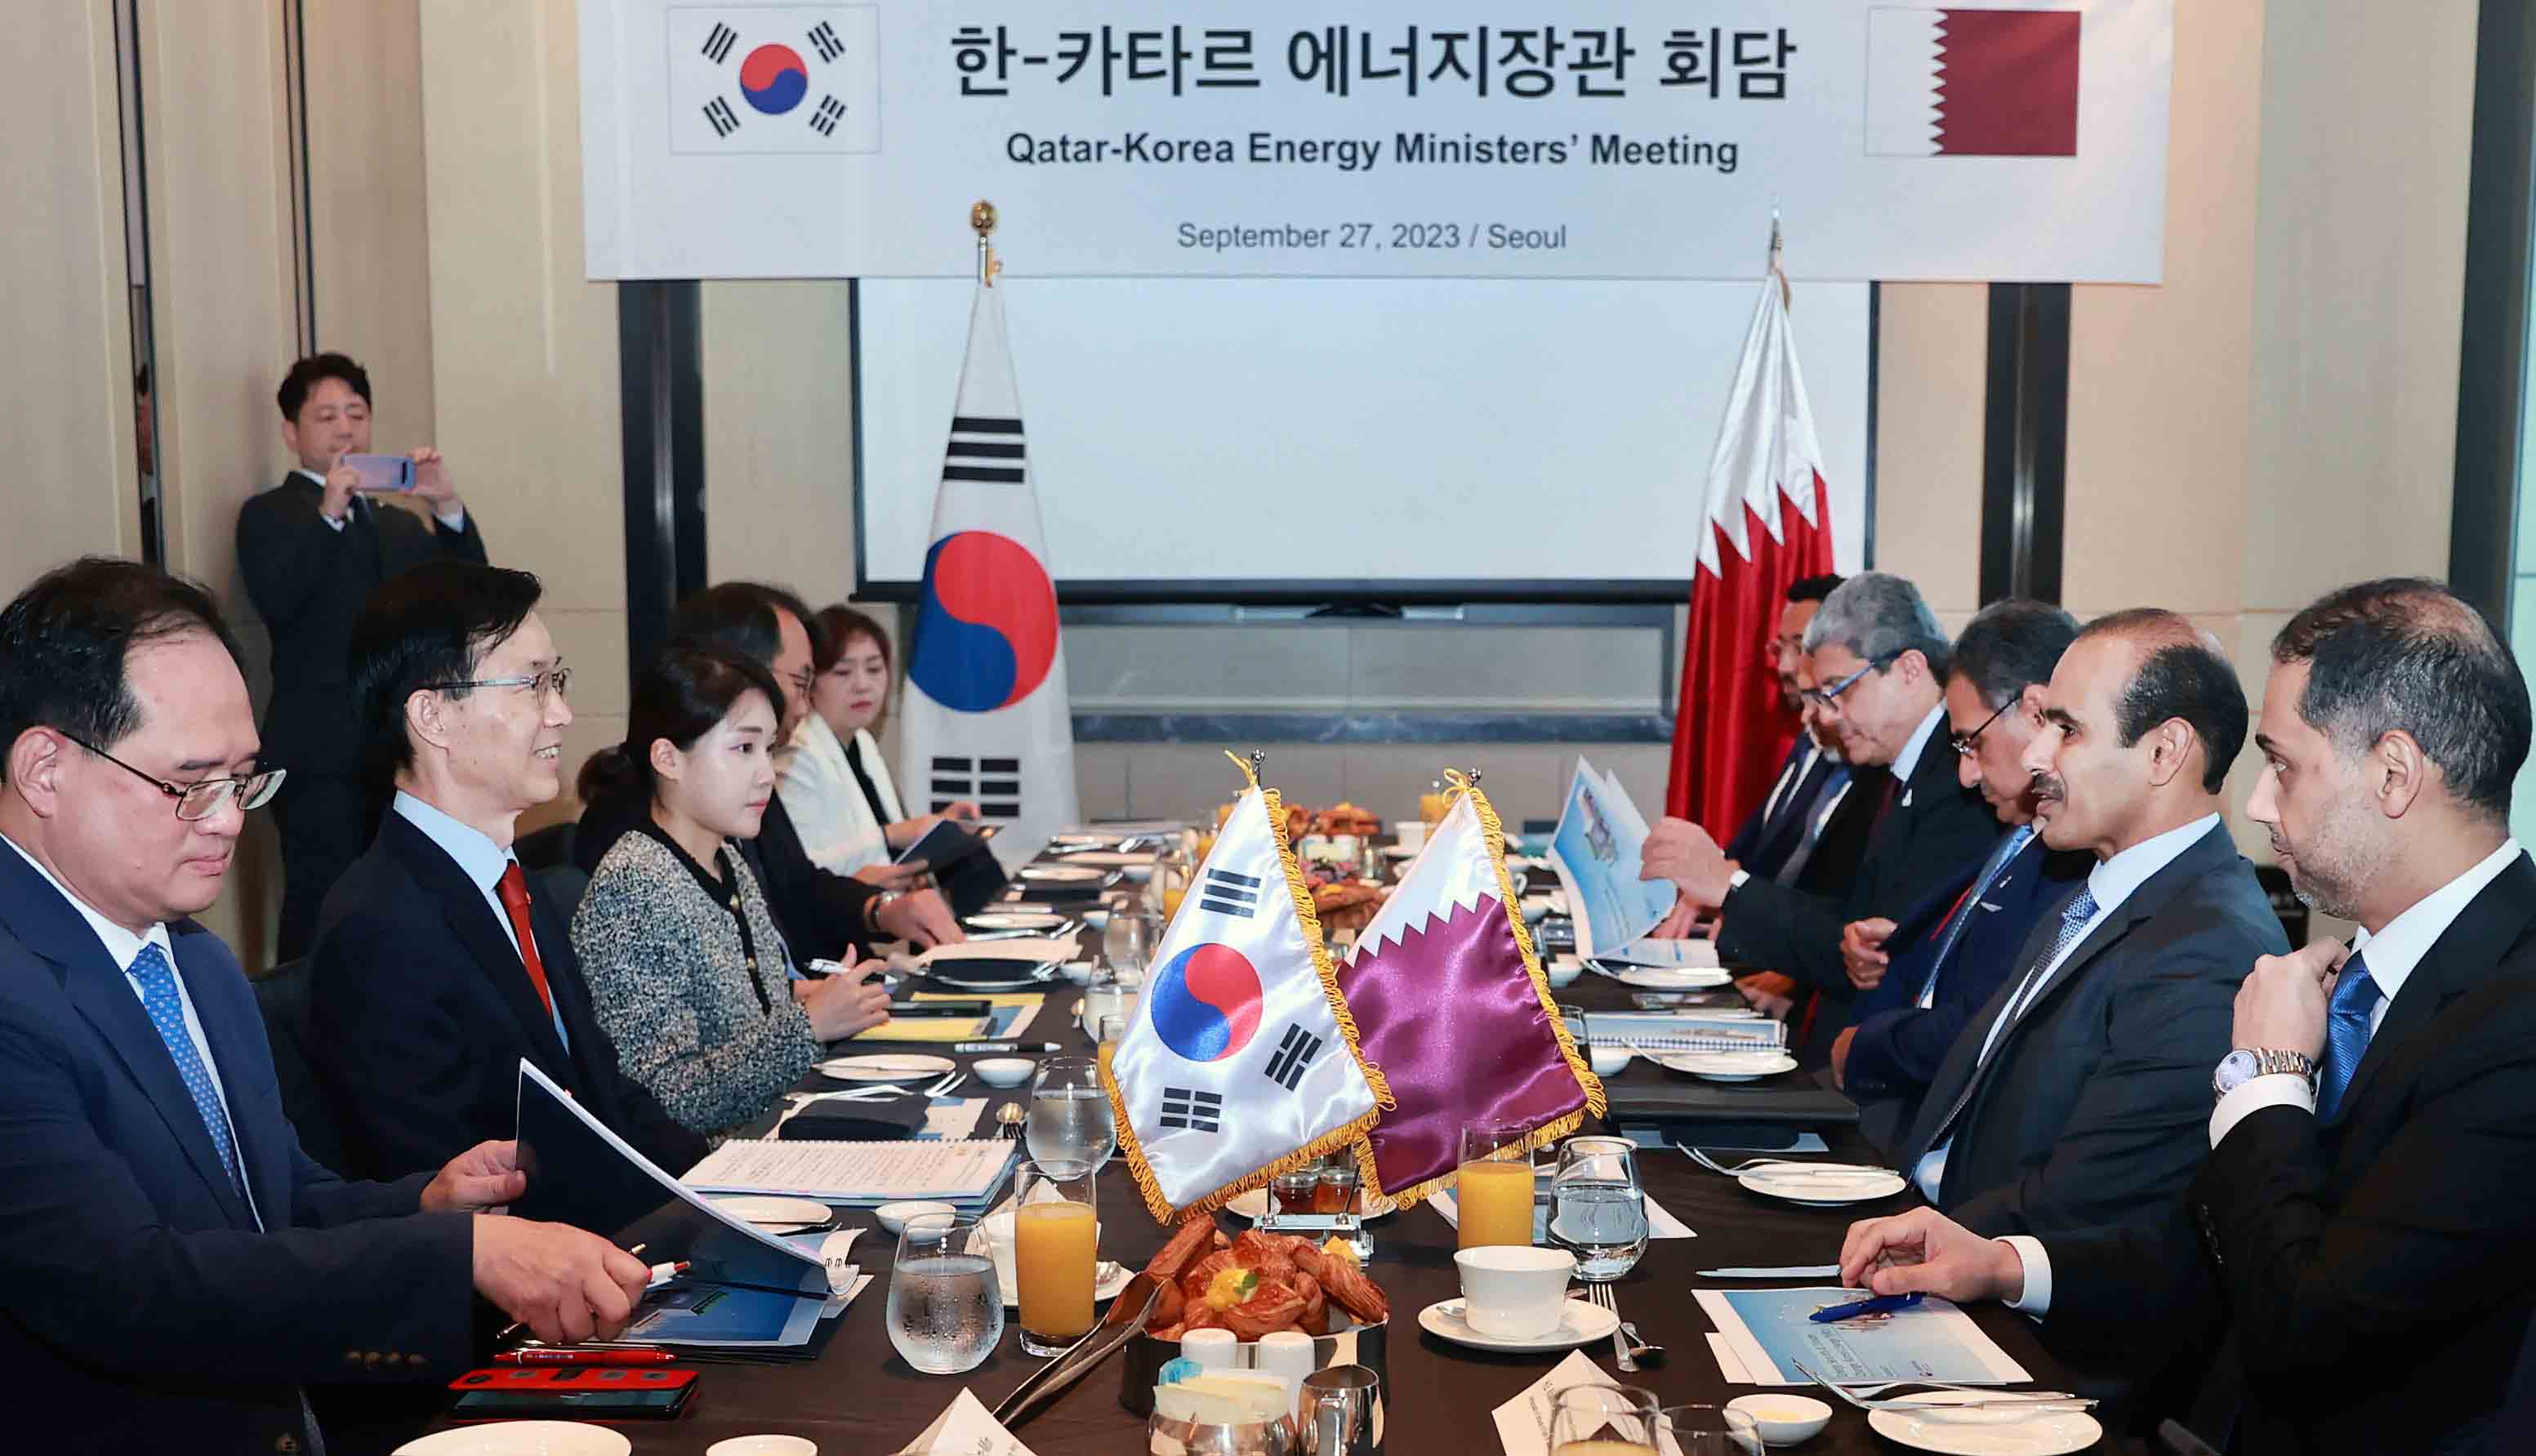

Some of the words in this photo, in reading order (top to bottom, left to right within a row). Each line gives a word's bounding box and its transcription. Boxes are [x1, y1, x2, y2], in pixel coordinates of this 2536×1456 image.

[950, 24, 1262, 98] 한-카타르
[1286, 24, 1637, 100] 에너지장관
[1659, 26, 1798, 100] 회담
[1005, 131, 1235, 166] Qatar-Korea
[1248, 131, 1382, 172] Energy
[1395, 131, 1579, 165] Ministers’
[1590, 133, 1739, 175] Meeting
[1177, 221, 1331, 255] September
[1339, 221, 1382, 251] 27,
[1391, 221, 1461, 250] 2023
[1469, 223, 1480, 250] /
[1486, 221, 1567, 250] Seoul
